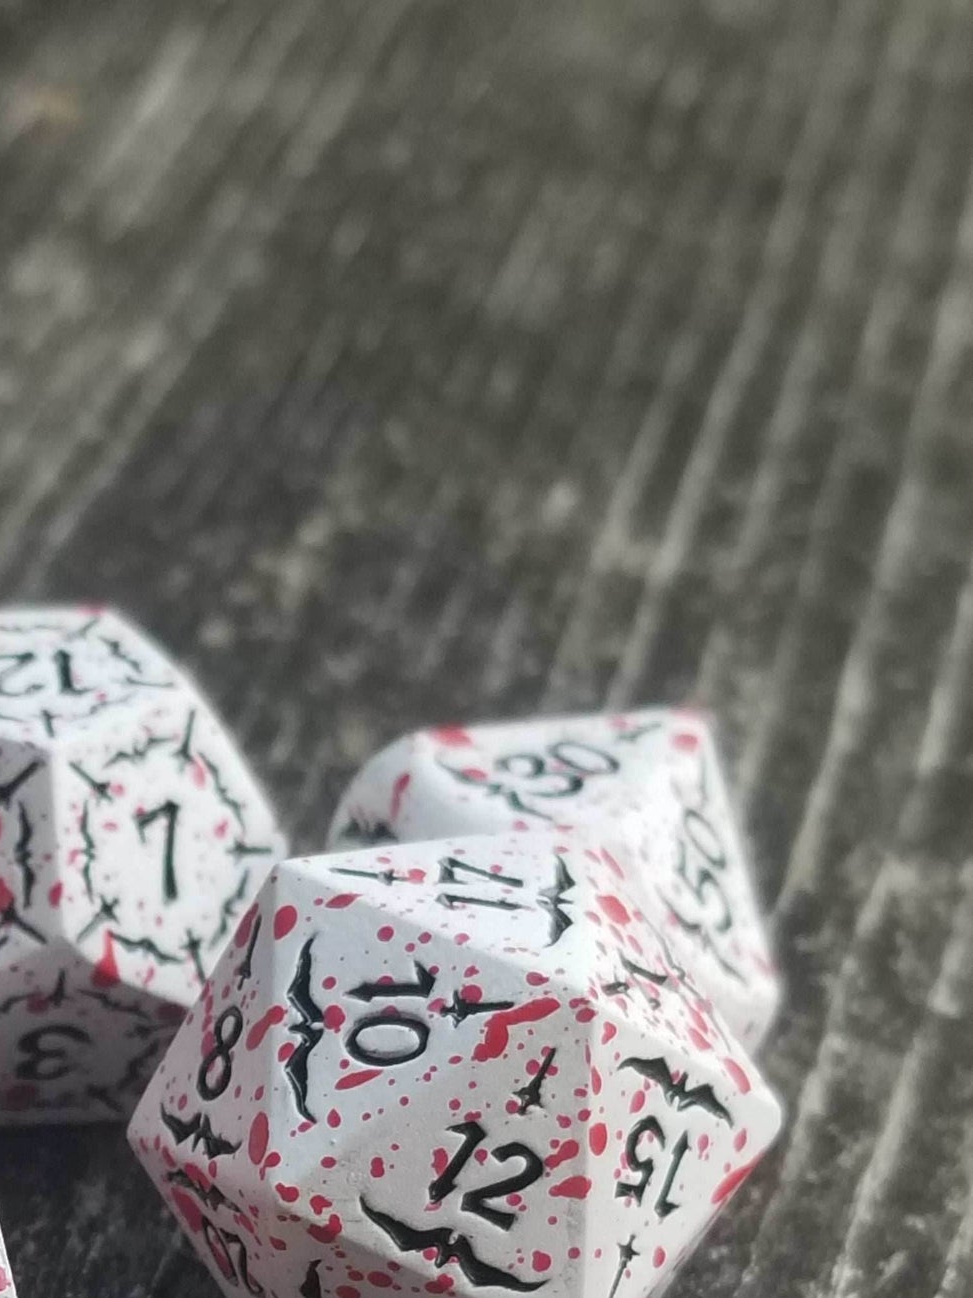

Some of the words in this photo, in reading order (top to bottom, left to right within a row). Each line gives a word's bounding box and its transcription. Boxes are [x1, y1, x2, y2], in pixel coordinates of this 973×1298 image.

[495, 741, 620, 798] 30
[196, 1005, 243, 1100] 8
[344, 959, 436, 1067] 10
[427, 1121, 545, 1230] 12
[614, 1116, 689, 1219] 15
